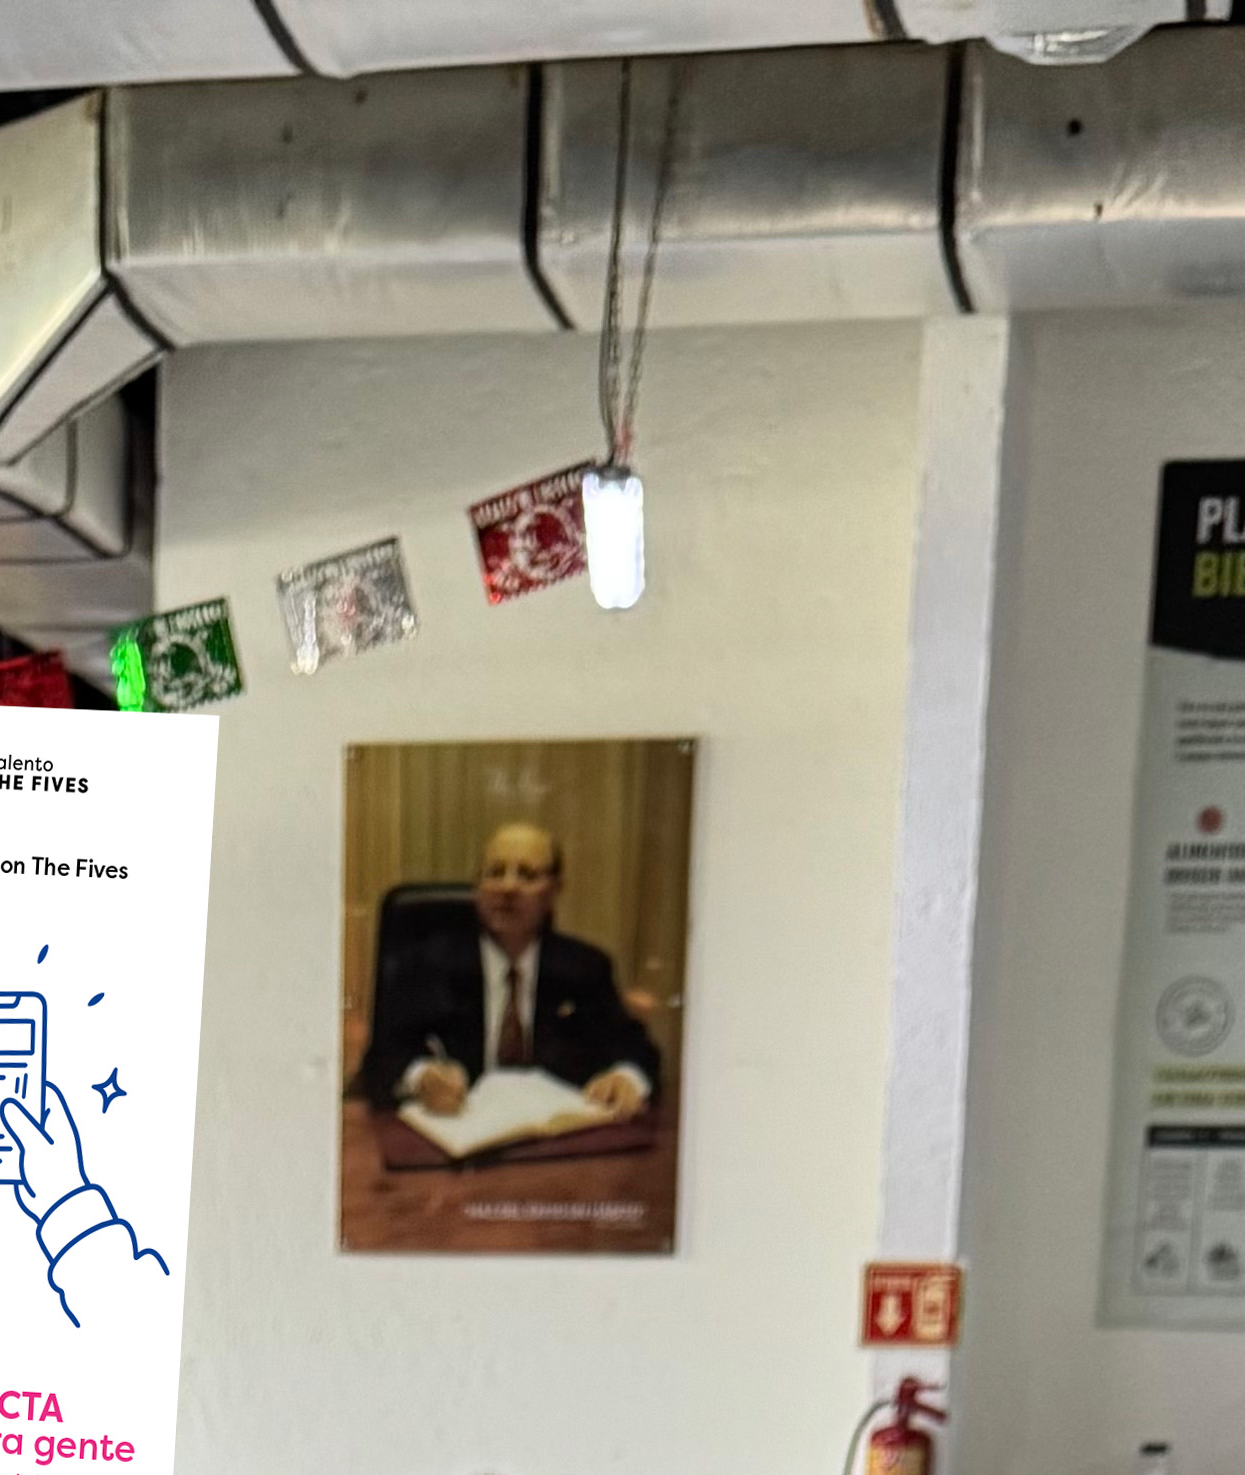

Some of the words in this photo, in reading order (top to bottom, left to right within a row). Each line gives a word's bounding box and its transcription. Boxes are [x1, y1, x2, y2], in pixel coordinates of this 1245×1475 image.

[1196, 495, 1245, 545] PL
[31, 775, 89, 794] FIVES
[31, 856, 71, 877] The
[75, 858, 129, 880] Fives
[34, 1434, 135, 1466] gente
